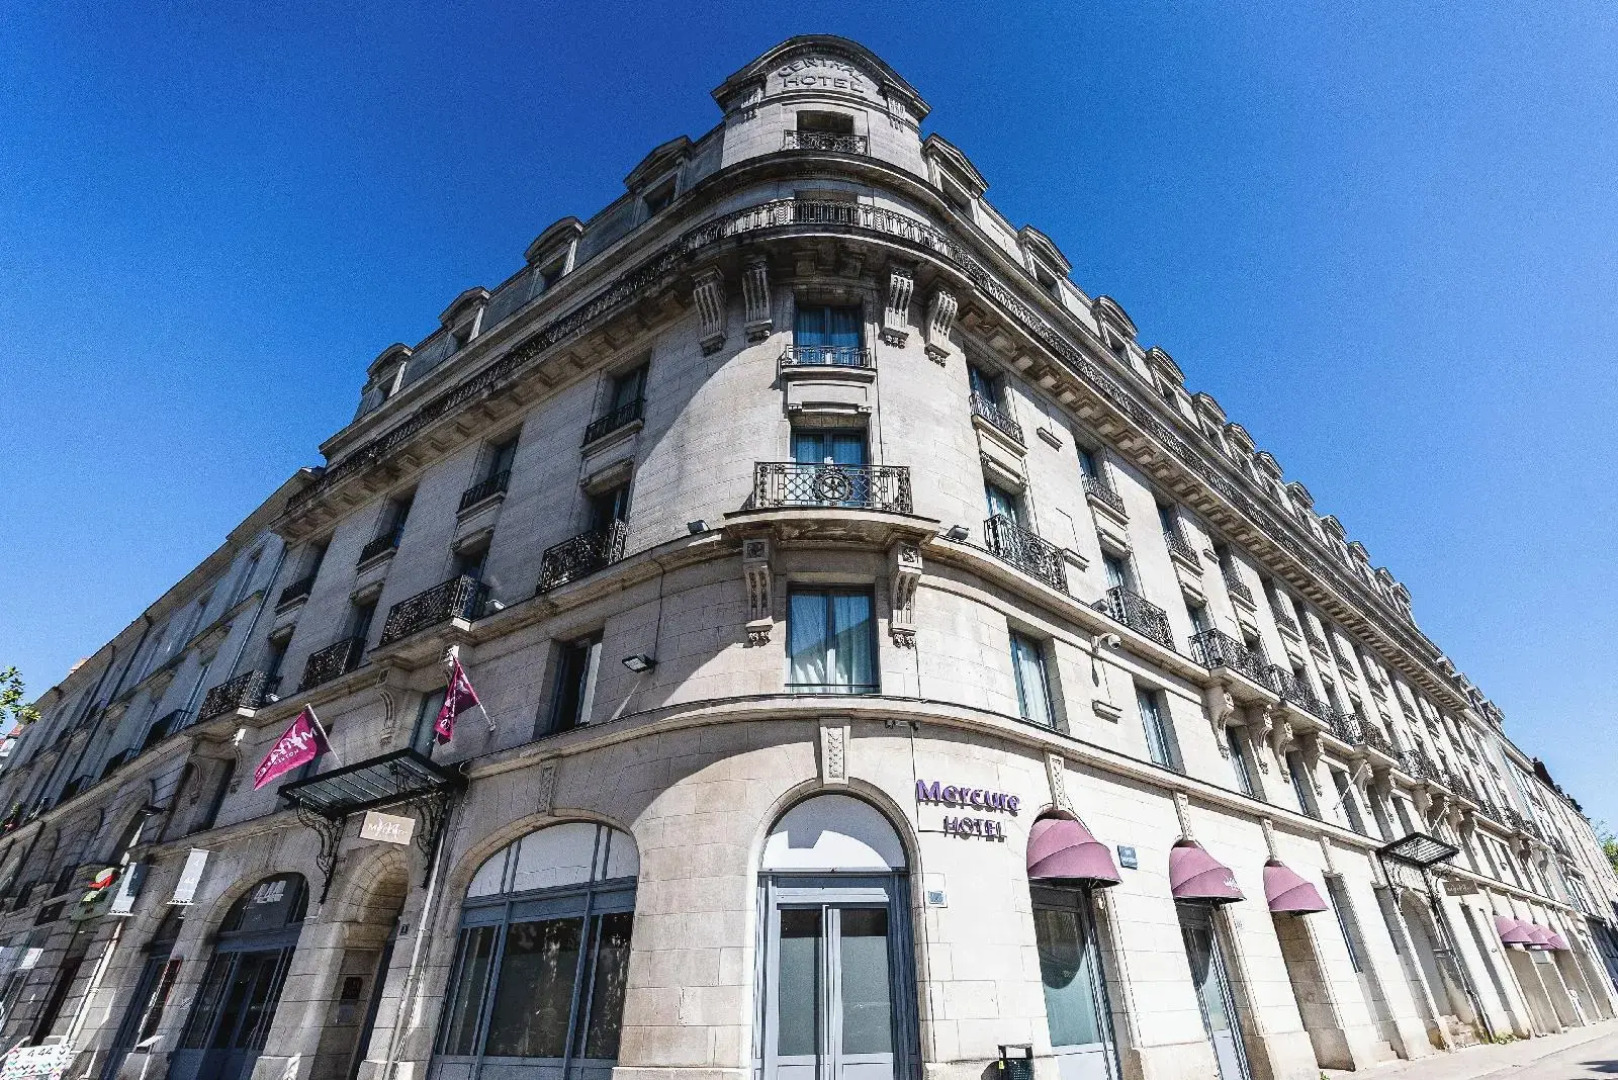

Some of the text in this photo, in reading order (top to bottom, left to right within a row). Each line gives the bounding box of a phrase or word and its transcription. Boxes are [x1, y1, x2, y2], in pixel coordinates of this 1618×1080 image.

[777, 57, 864, 84] CENTRAL
[783, 75, 864, 93] HOTEL
[916, 779, 1021, 811] Mercure
[943, 815, 1003, 837] HOTEL
